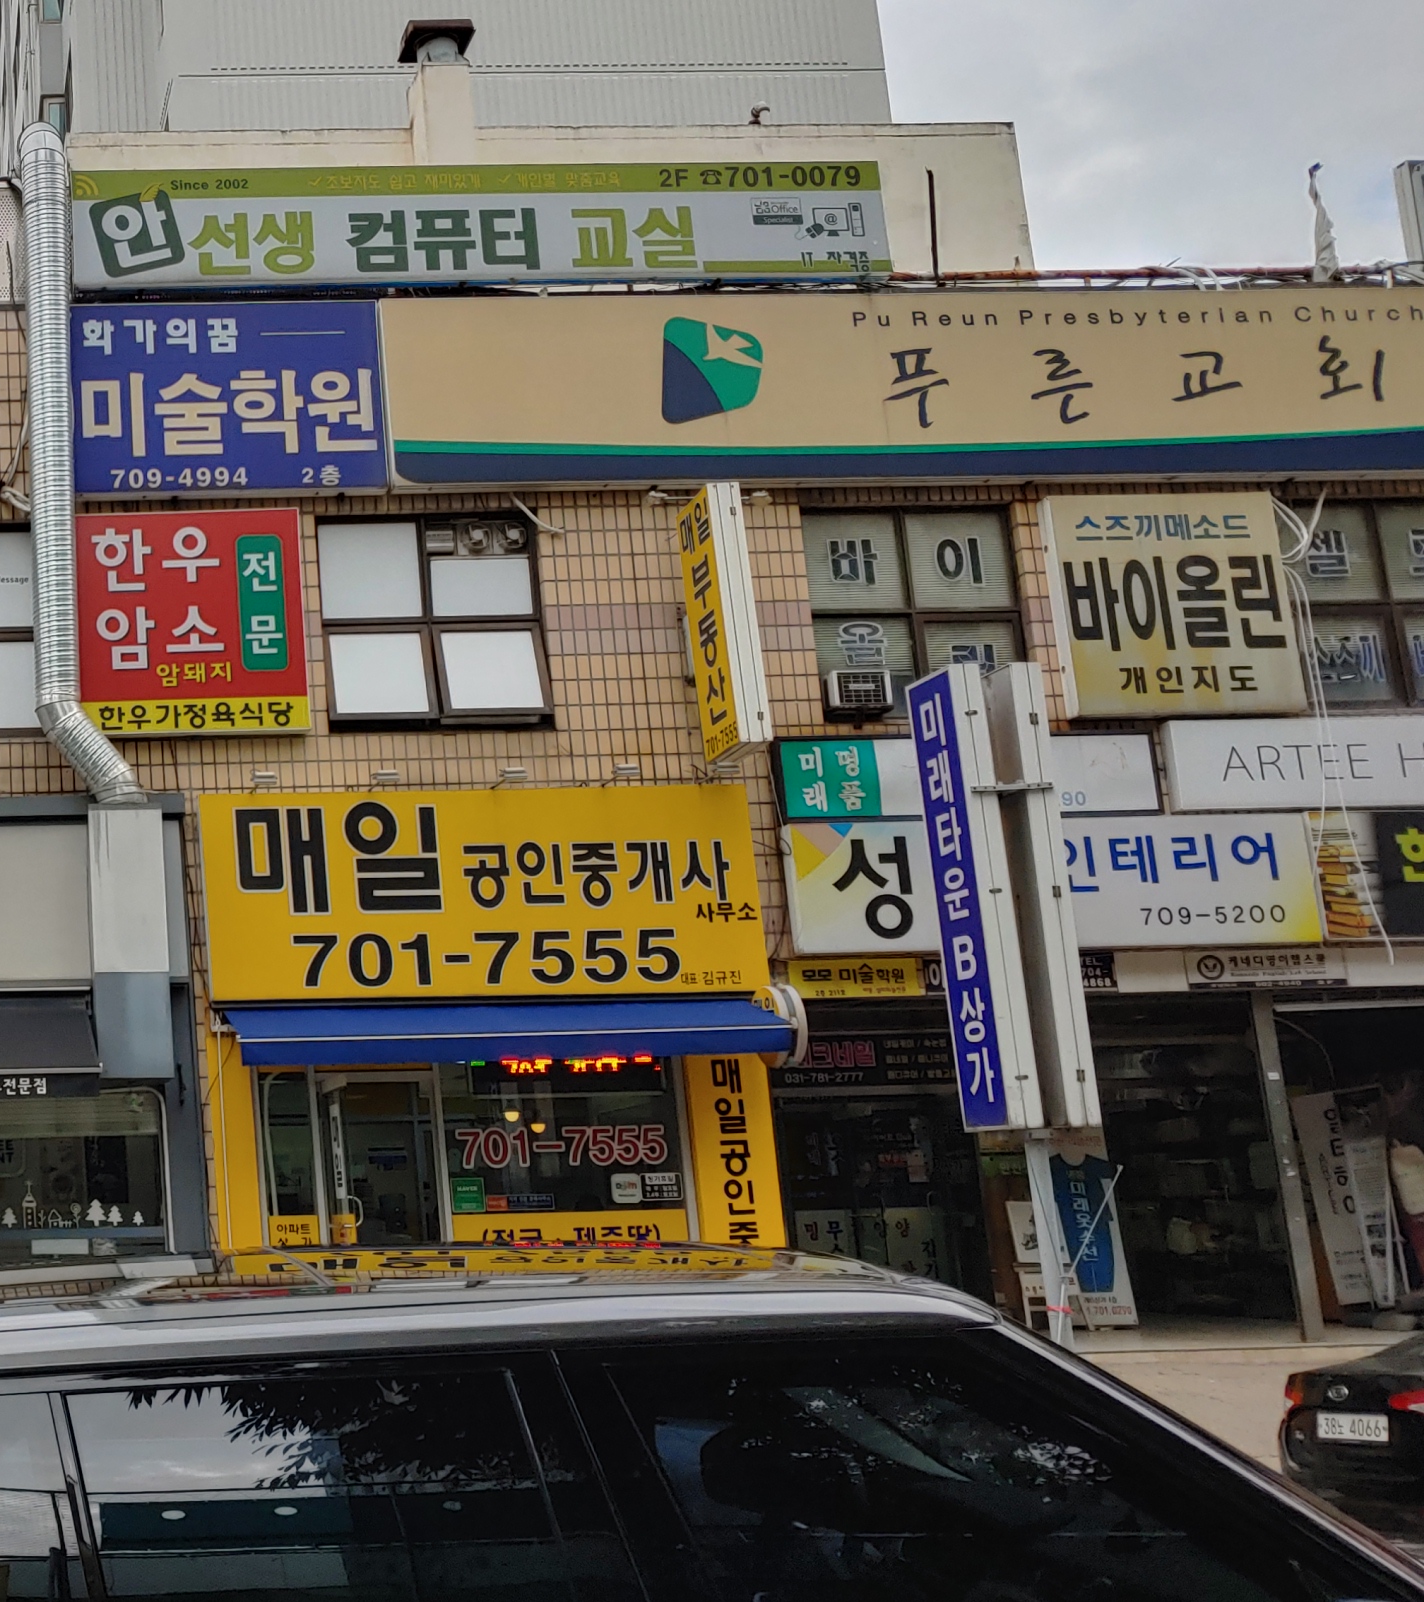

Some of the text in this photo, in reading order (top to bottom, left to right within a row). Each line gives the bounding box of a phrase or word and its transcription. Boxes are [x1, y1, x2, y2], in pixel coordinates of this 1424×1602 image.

[170, 178, 249, 192] Since 2002
[390, 174, 418, 189] 쉽고
[659, 165, 861, 188] 2F 701-0079
[345, 206, 541, 273] 컴퓨터
[570, 205, 699, 270] 교실
[800, 251, 871, 273] IT 자격증
[852, 305, 1424, 328] Pu Reun Presbyterian Church
[80, 368, 378, 458] 미술학원
[110, 466, 249, 489] 709-4994
[679, 497, 711, 556] 매일
[91, 526, 221, 593] 한우
[242, 551, 284, 655] 전문
[1063, 553, 1288, 653] 바이올린
[95, 605, 225, 671] 암소
[691, 553, 728, 727] 부동산
[155, 661, 233, 687] 암돼지
[1119, 665, 1259, 695] 개인지도
[99, 701, 295, 731] 한우가정육식당
[705, 720, 739, 757] 701-7555
[1222, 743, 1374, 783] ARTEE
[232, 800, 731, 916] 매일 공인중개사
[832, 835, 914, 940] 성
[695, 901, 759, 923] 사무소
[1139, 904, 1287, 927] 709-5200
[290, 926, 683, 989] 701-7555
[701, 969, 743, 986] 김규진
[801, 968, 833, 983] 모모
[838, 962, 906, 985] 미술학원
[454, 1123, 669, 1169] 701-7555
[276, 1222, 312, 1236] 아파트
[1349, 1418, 1382, 1438] 4066
